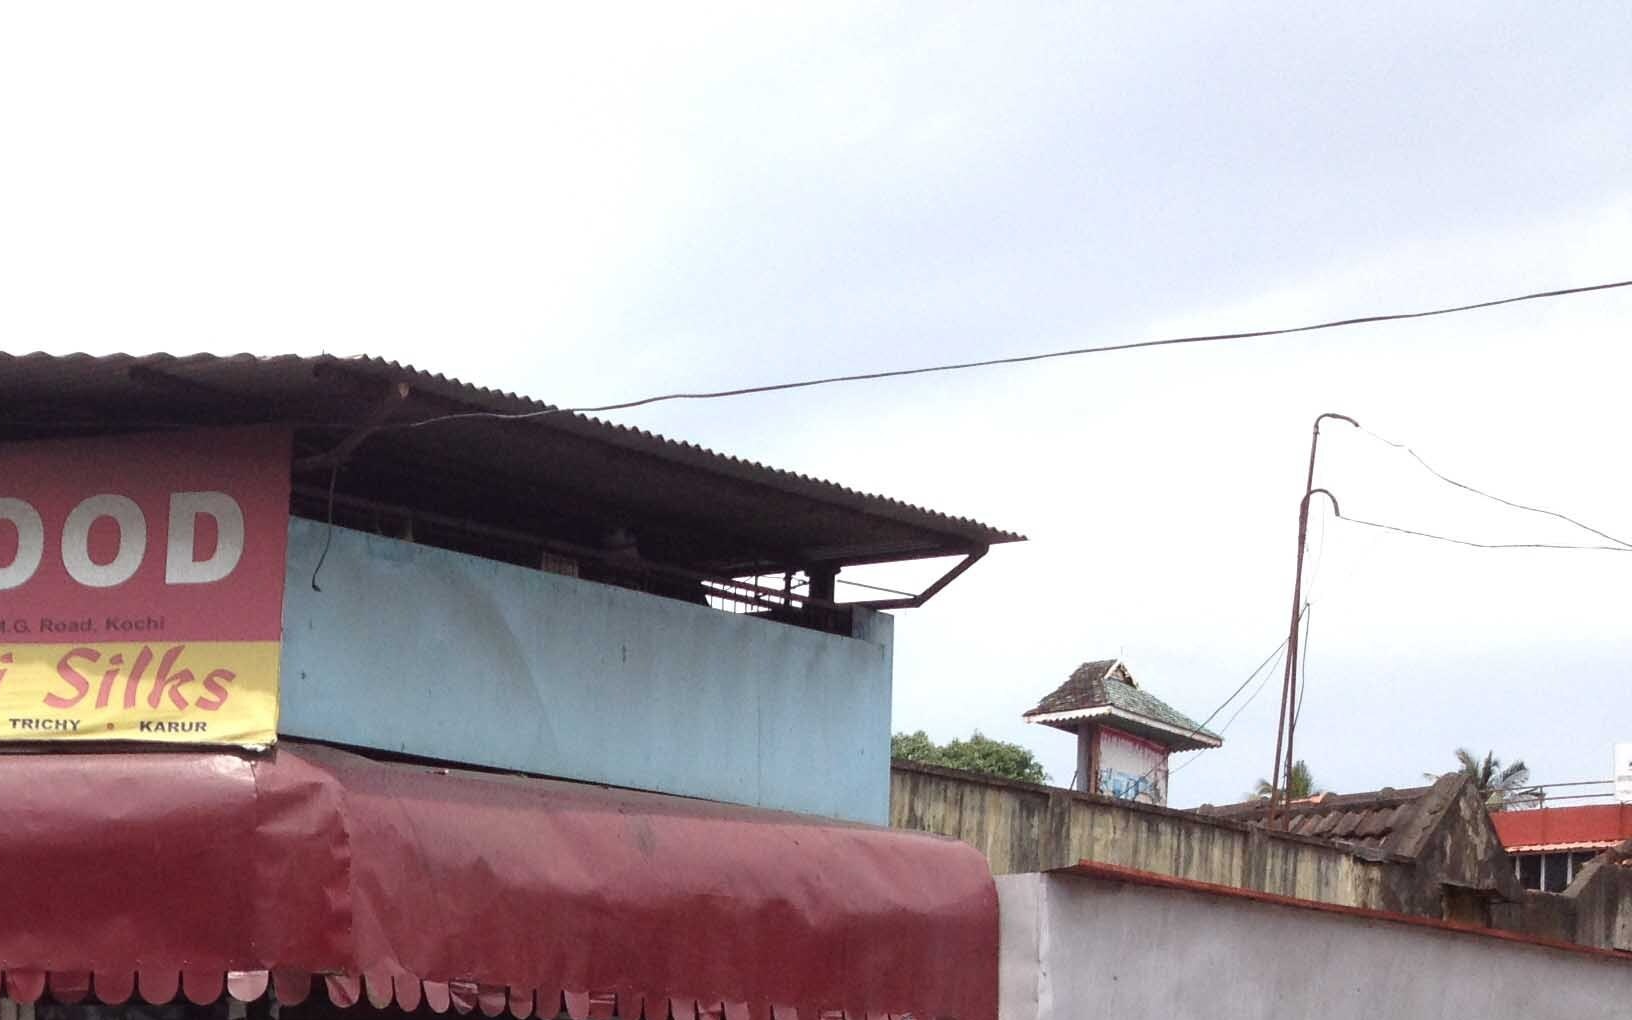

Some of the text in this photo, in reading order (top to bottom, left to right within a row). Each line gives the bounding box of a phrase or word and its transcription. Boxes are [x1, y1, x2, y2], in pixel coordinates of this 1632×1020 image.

[105, 615, 166, 632] Kochi
[40, 645, 238, 713] Silks
[9, 718, 81, 731] TRICHY
[139, 720, 208, 733] KARUR
